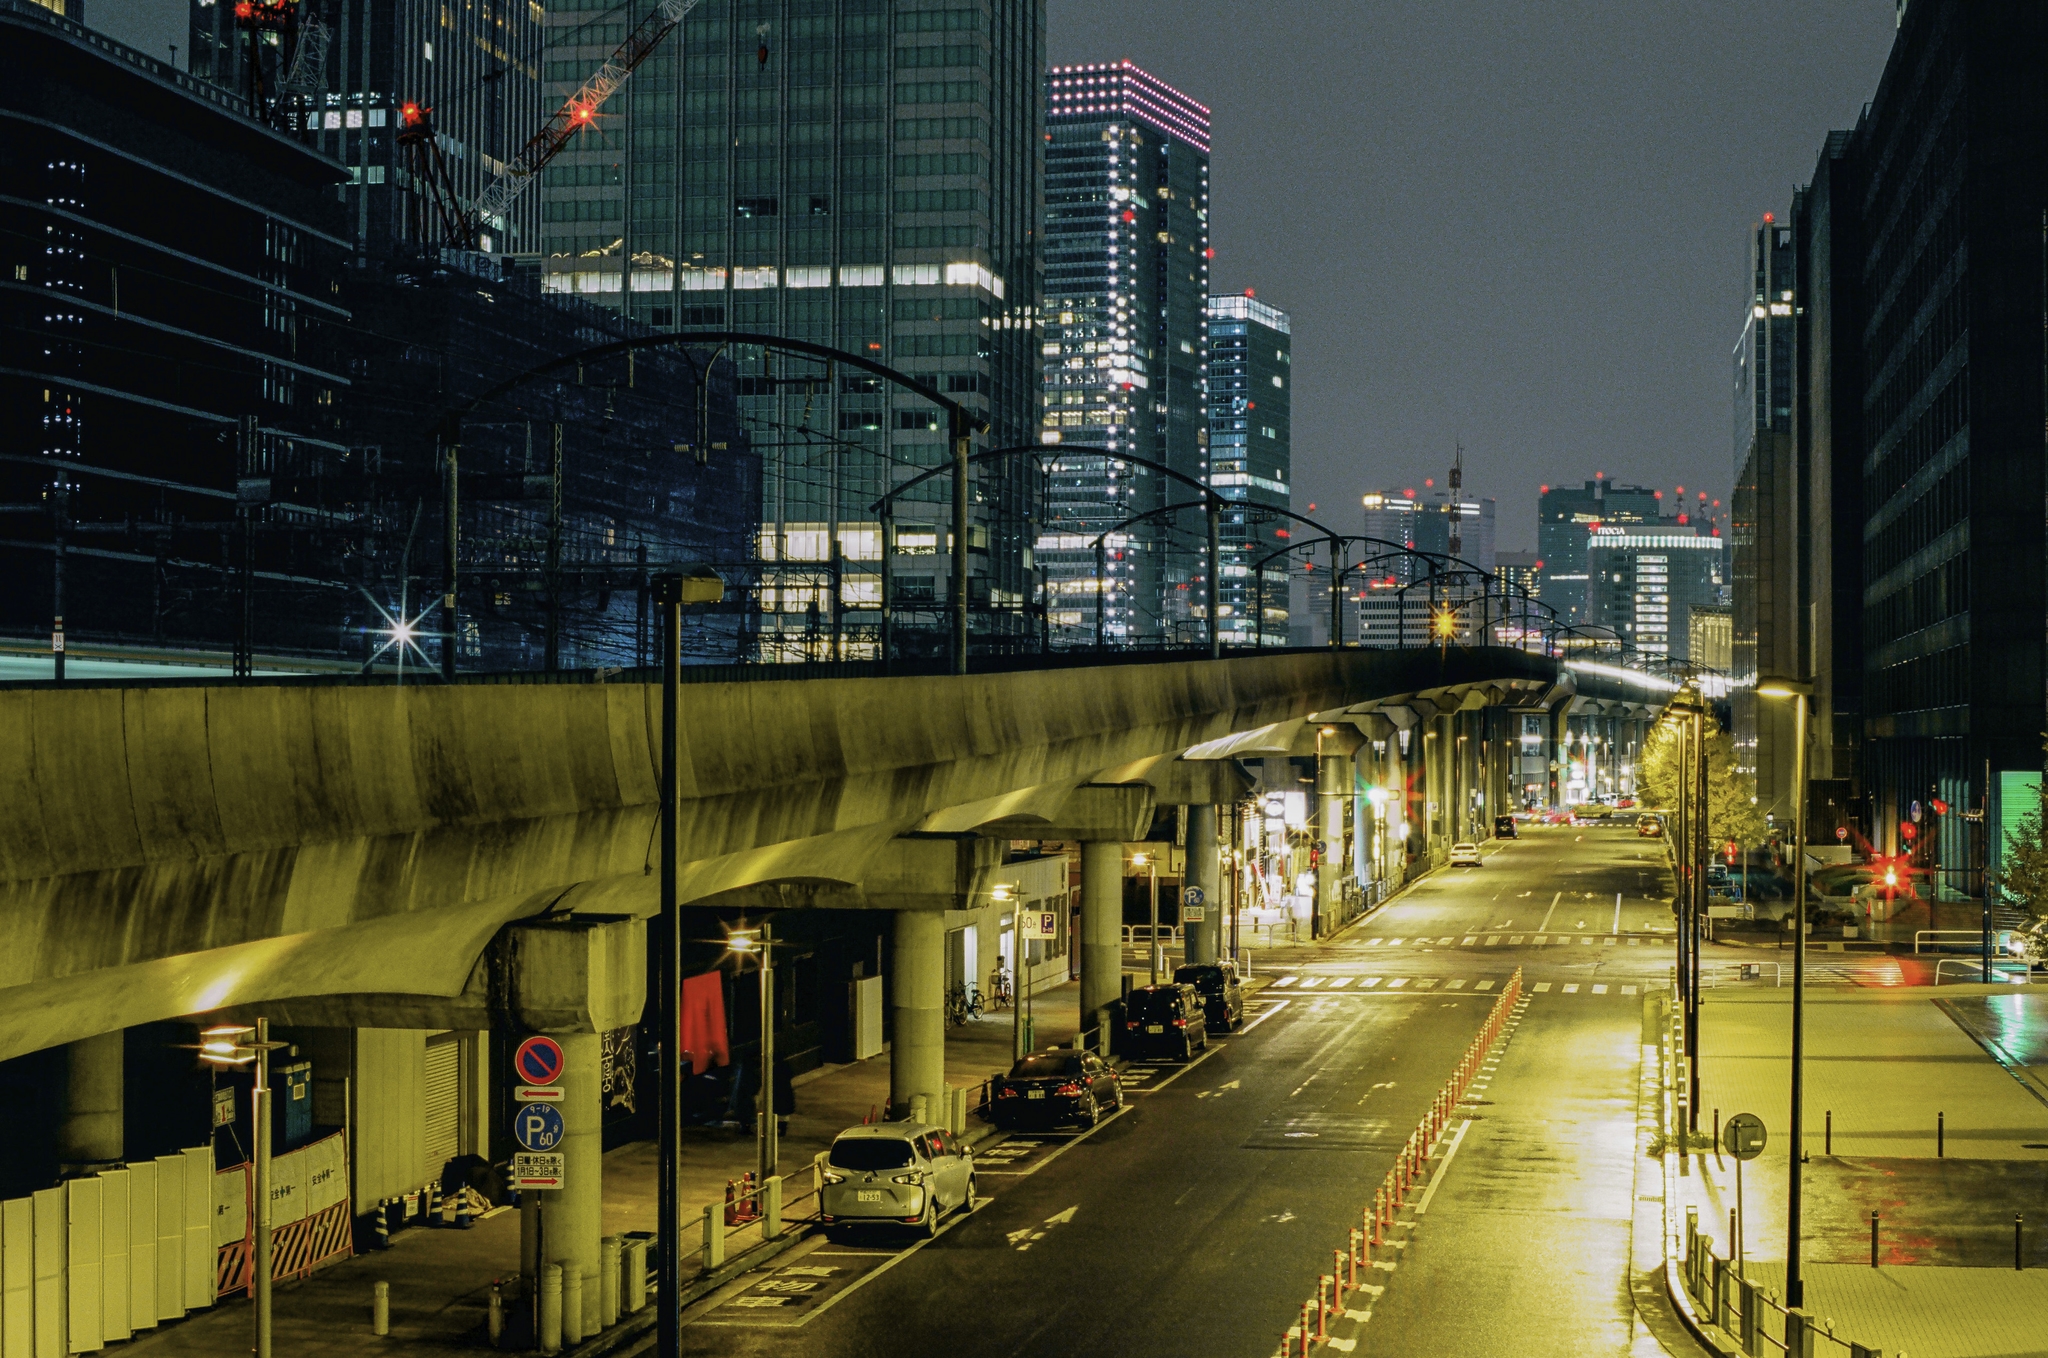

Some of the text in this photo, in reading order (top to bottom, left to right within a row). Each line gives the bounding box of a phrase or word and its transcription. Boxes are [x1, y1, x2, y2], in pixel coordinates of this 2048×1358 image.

[1044, 915, 1052, 927] P
[530, 1104, 551, 1114] 9-19
[527, 1115, 545, 1146] P
[539, 1131, 553, 1146] 60
